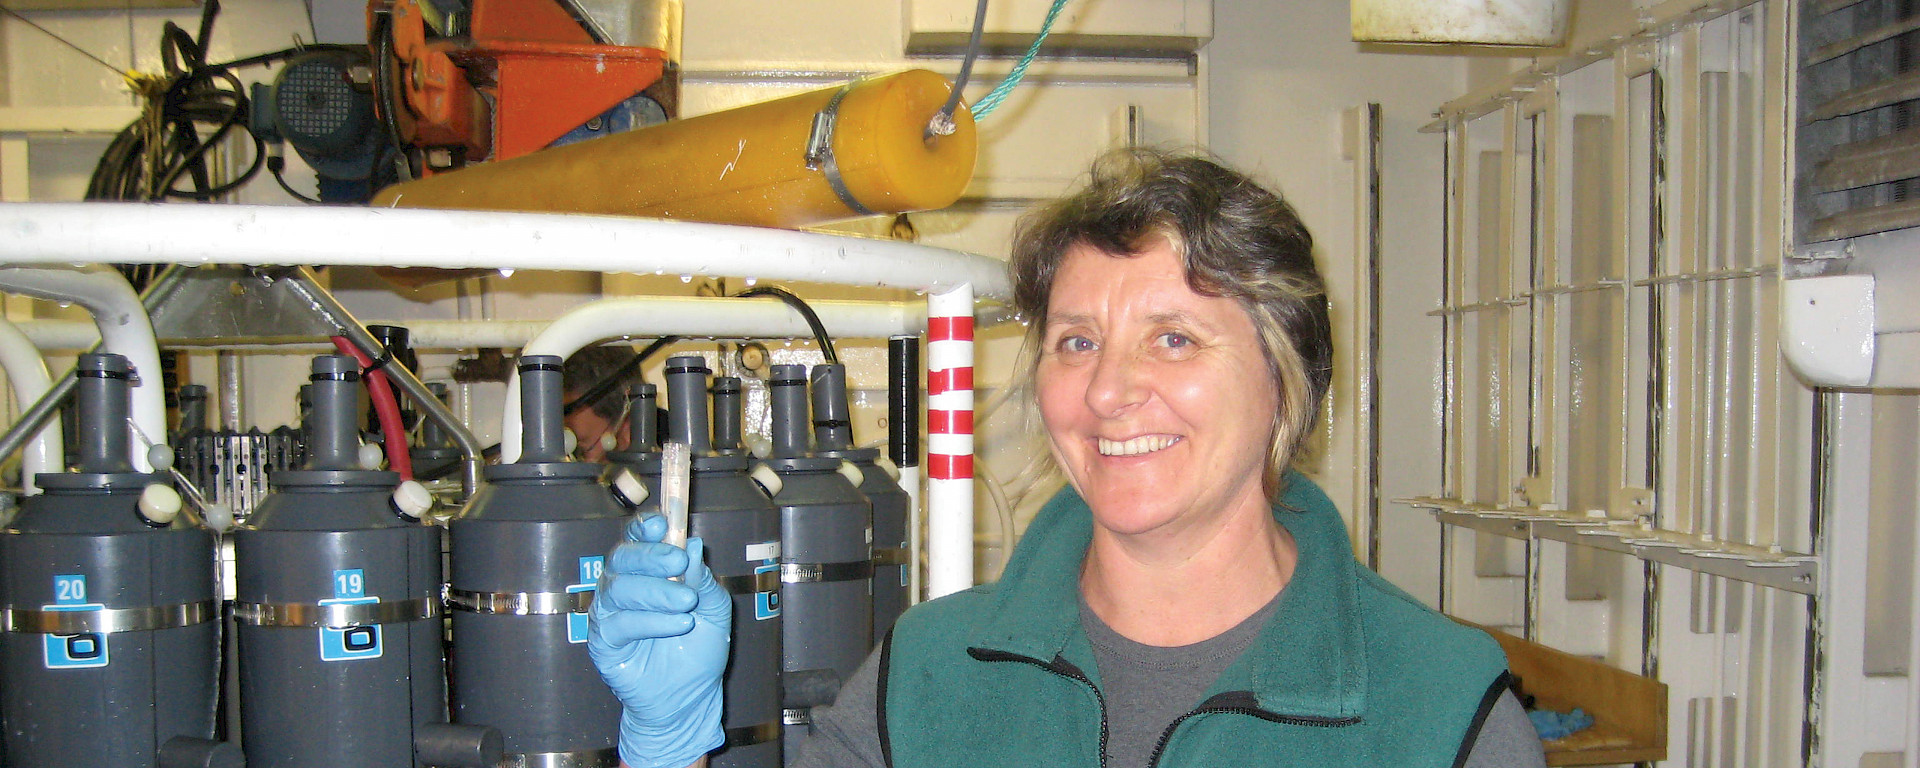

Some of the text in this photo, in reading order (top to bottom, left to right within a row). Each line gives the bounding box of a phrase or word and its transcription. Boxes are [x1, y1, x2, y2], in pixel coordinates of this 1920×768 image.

[583, 560, 602, 580] 18
[58, 579, 85, 600] 20
[338, 573, 362, 594] 19
